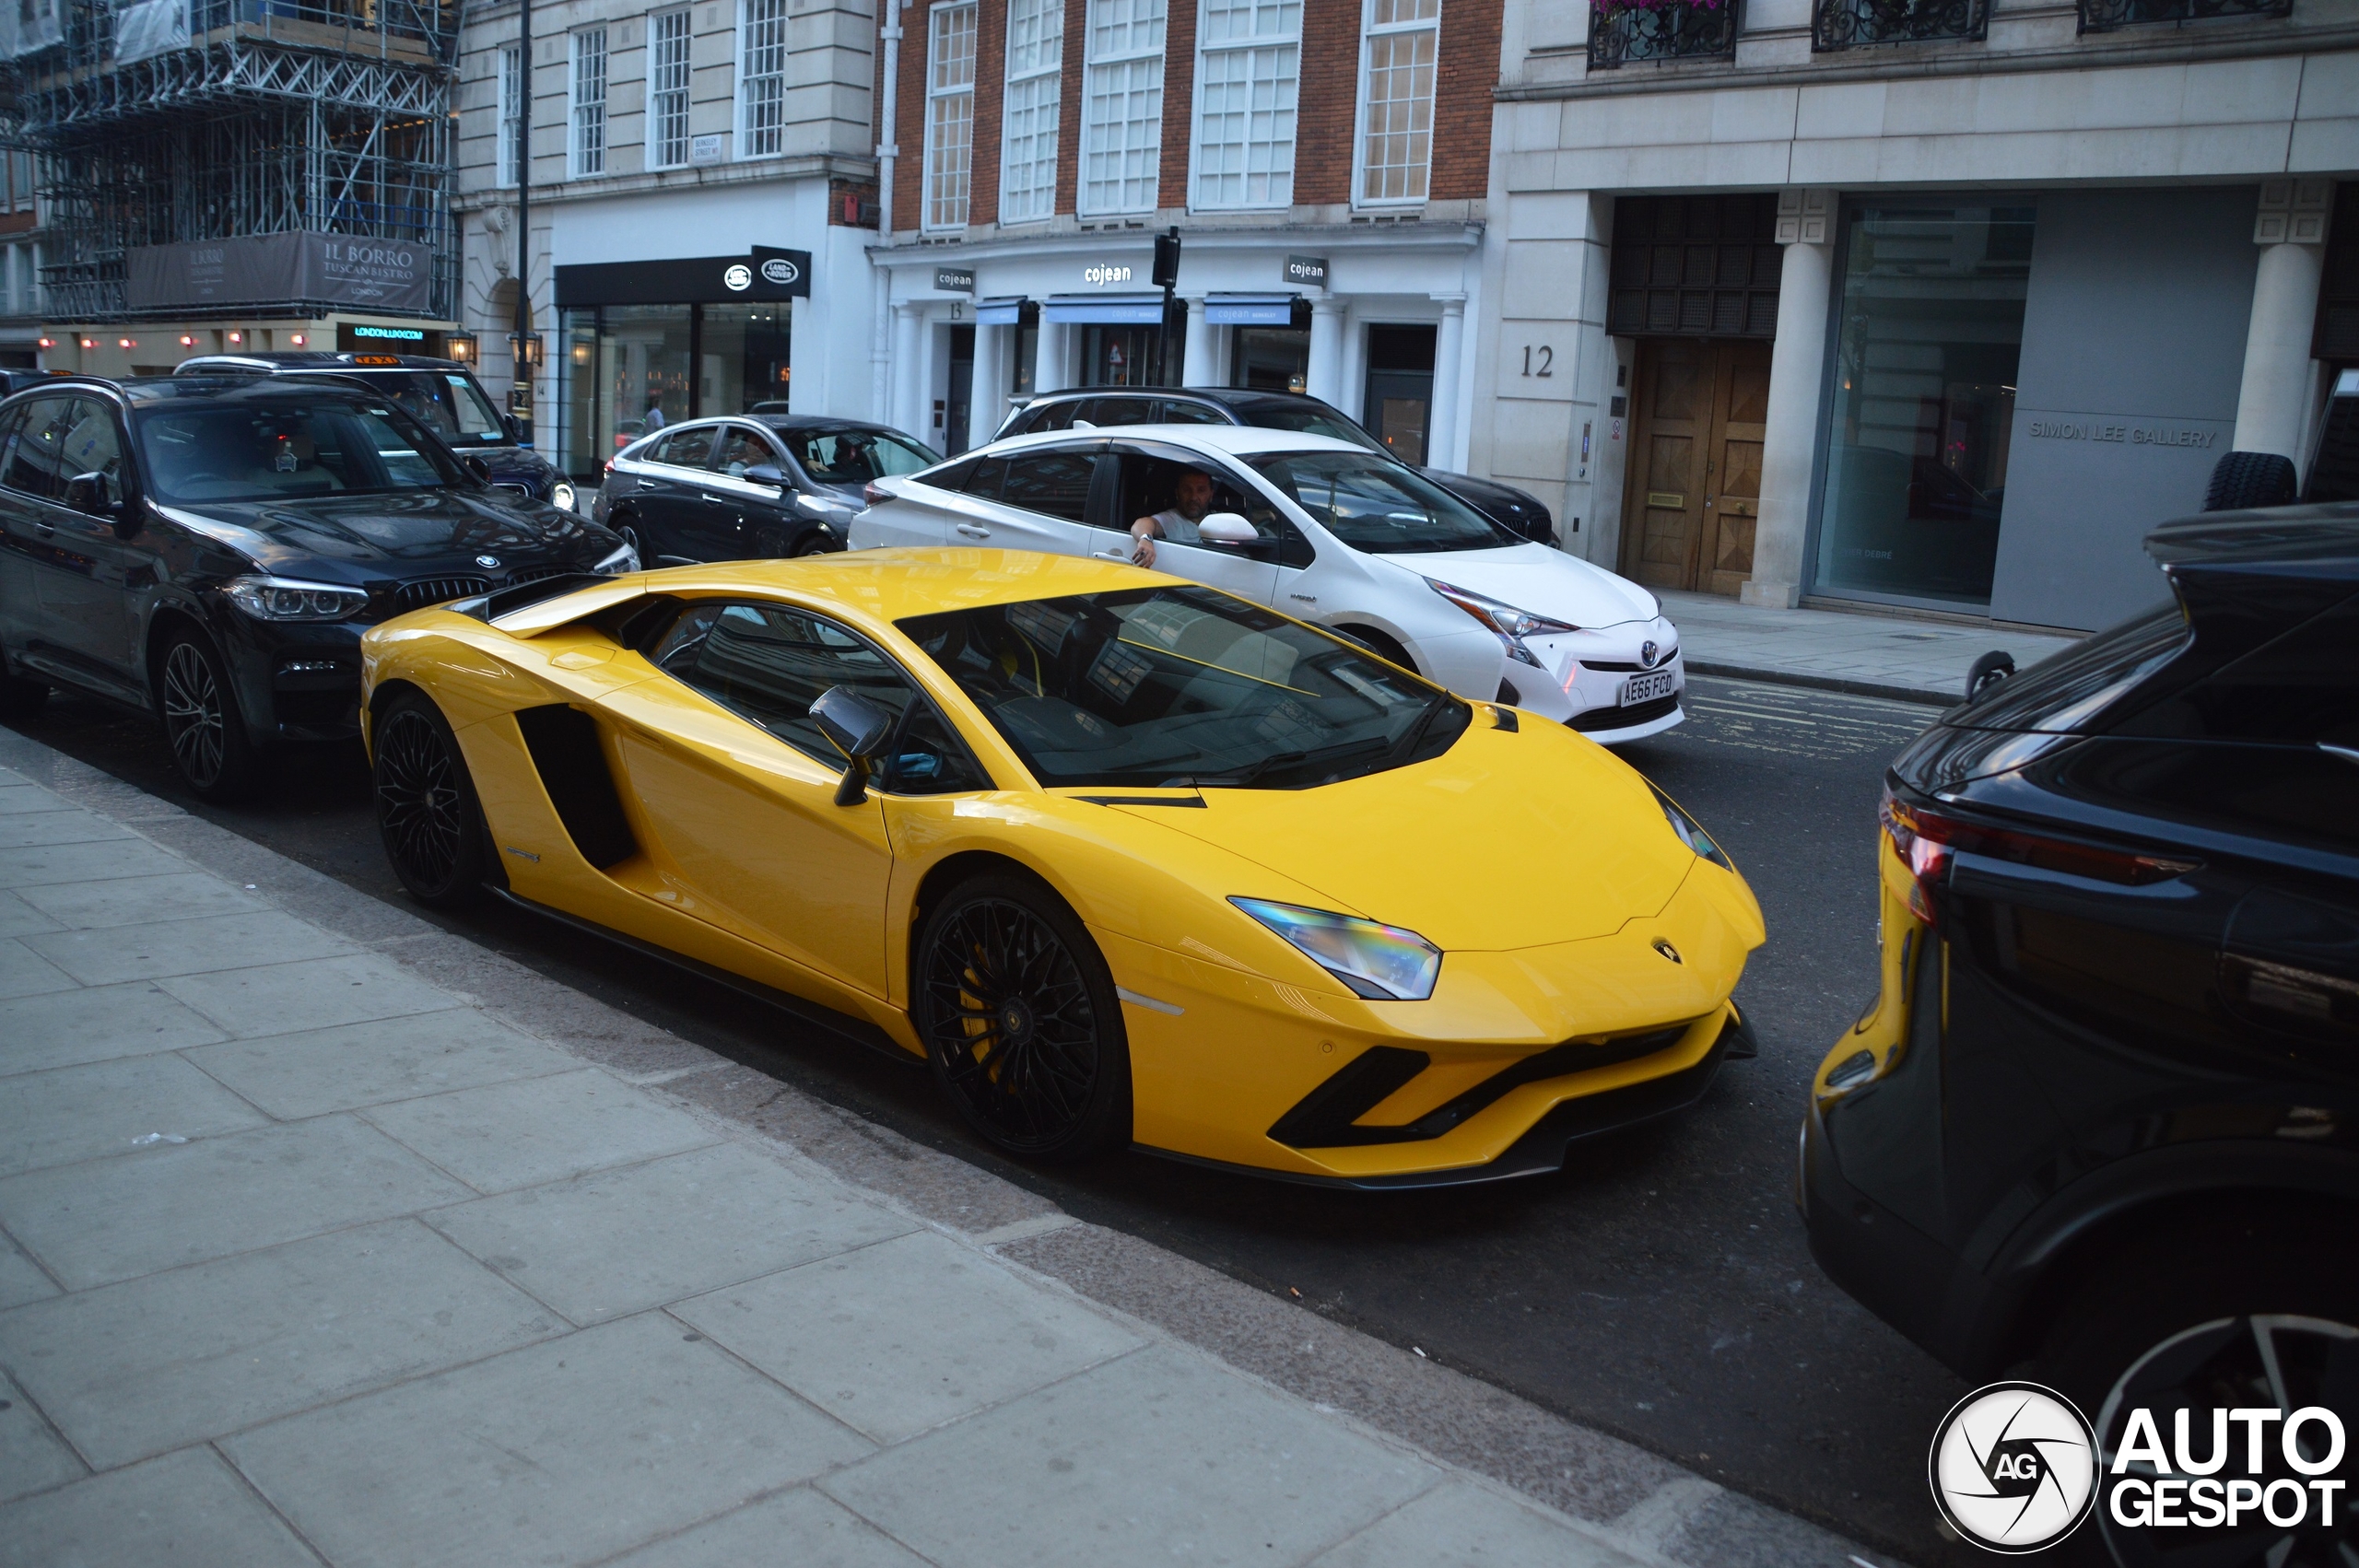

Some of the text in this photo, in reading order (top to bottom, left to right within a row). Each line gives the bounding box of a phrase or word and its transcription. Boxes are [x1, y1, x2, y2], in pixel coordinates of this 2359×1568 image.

[695, 147, 711, 157] STREET
[325, 243, 413, 267] IL BORRO
[323, 262, 414, 280] TUSCAN BISTRO
[769, 263, 786, 272] LAND
[769, 270, 792, 279] ROVER
[1085, 263, 1132, 287] cojean
[1290, 263, 1324, 278] cojean
[939, 273, 972, 287] cojean
[351, 287, 383, 297] LONDON
[950, 302, 962, 321] 13
[1218, 308, 1250, 321] cojean
[1520, 345, 1554, 378] 12
[2029, 421, 2215, 449] SIMON LEE GALLERY
[1625, 673, 1672, 703] AE66 FCD
